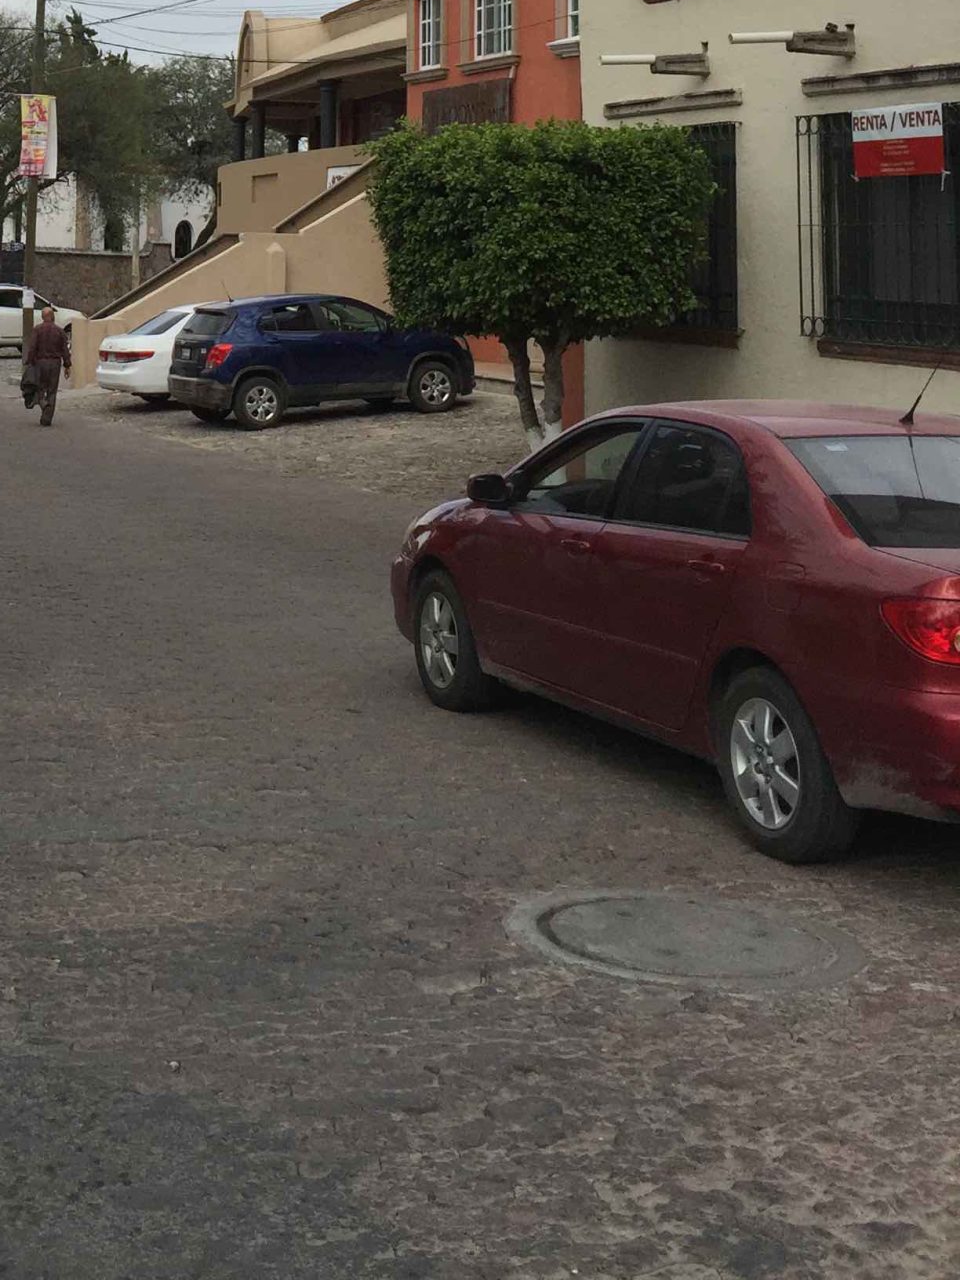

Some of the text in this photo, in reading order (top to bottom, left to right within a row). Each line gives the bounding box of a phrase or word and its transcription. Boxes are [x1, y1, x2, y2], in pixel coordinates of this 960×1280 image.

[852, 109, 942, 133] RENTA / VENTA
